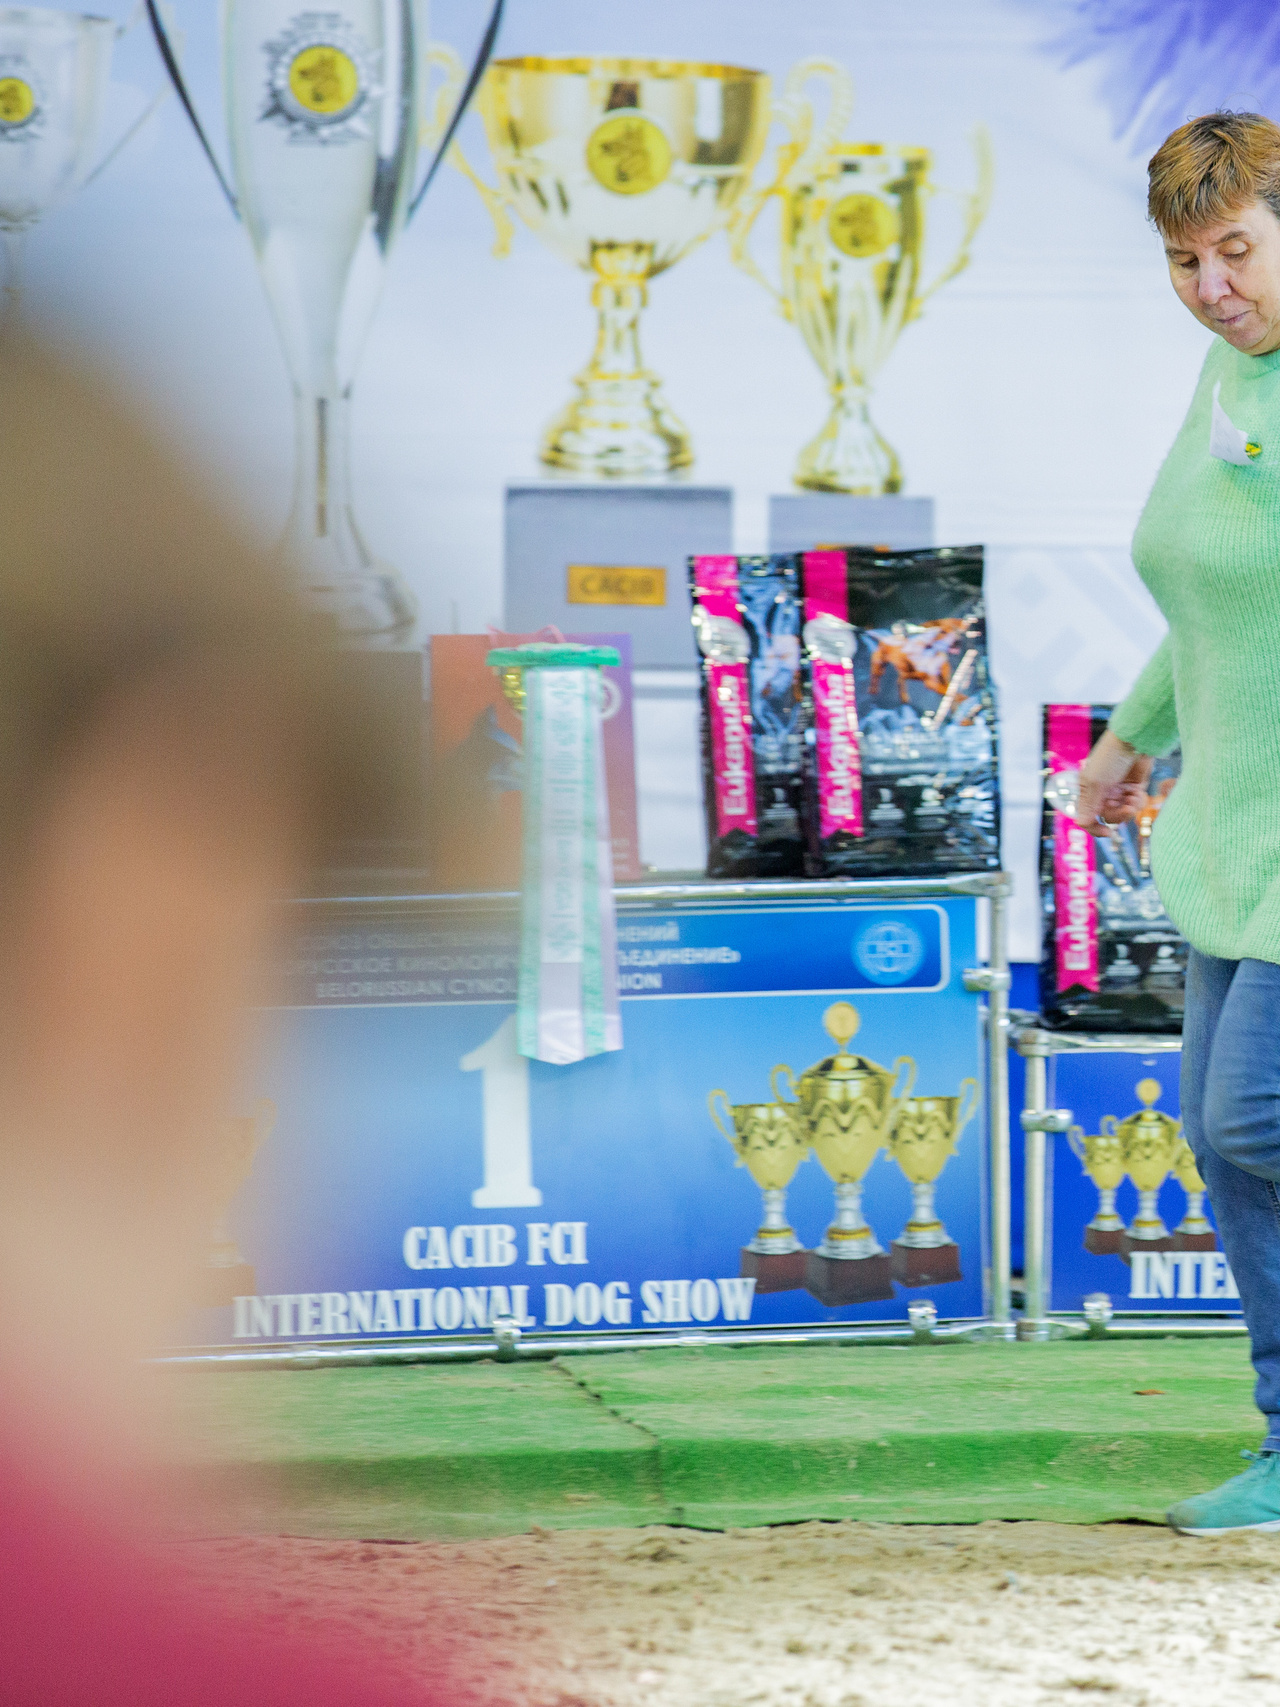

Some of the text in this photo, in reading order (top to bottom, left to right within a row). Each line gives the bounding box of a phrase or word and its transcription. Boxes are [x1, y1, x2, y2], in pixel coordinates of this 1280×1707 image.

[718, 674, 748, 816] Eukanuba
[823, 673, 853, 816] Eukanuba
[1063, 828, 1090, 971] Eukanuba
[459, 1012, 542, 1209] 1
[233, 1277, 757, 1338] INTERNATIONAL DOG SHOW
[403, 1221, 589, 1270] CACIB FCI
